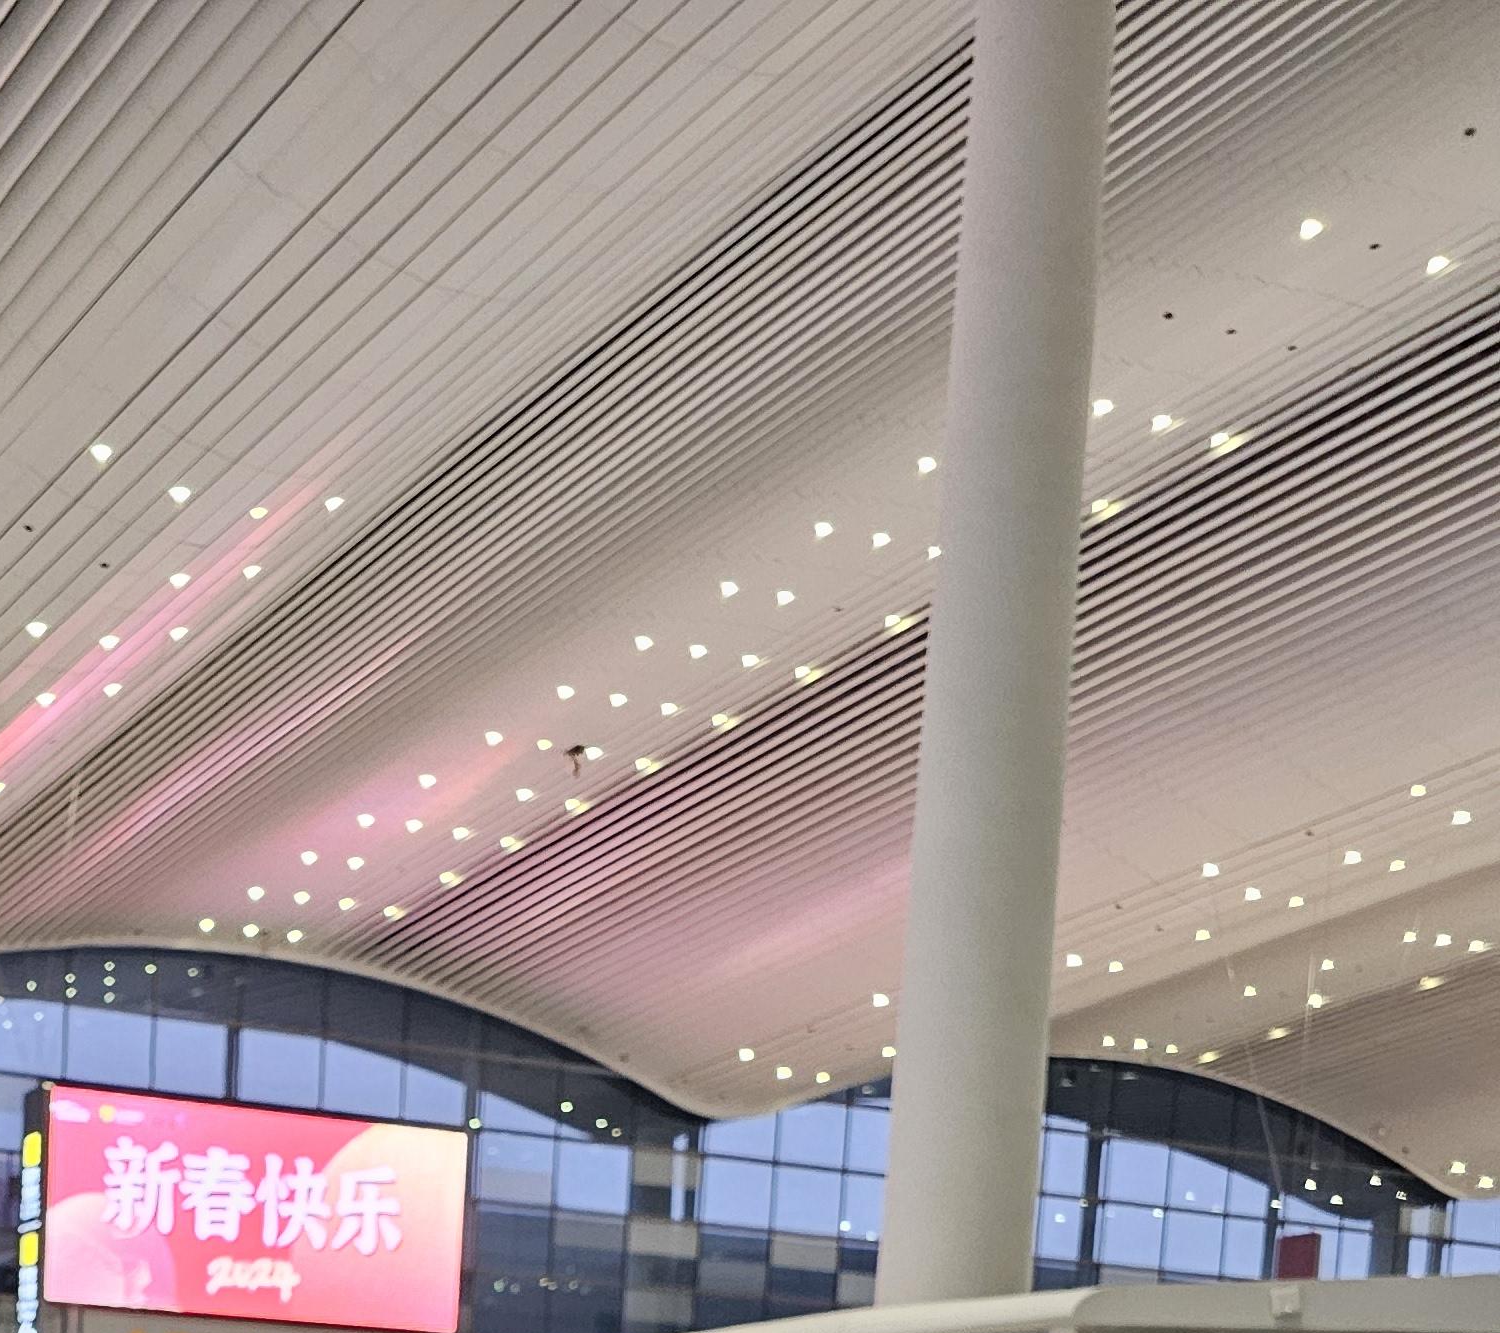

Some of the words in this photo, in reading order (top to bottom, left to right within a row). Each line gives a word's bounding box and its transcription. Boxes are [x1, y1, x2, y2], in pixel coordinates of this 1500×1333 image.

[101, 1136, 401, 1255] 新春快乐
[206, 1256, 300, 1303] 2024
